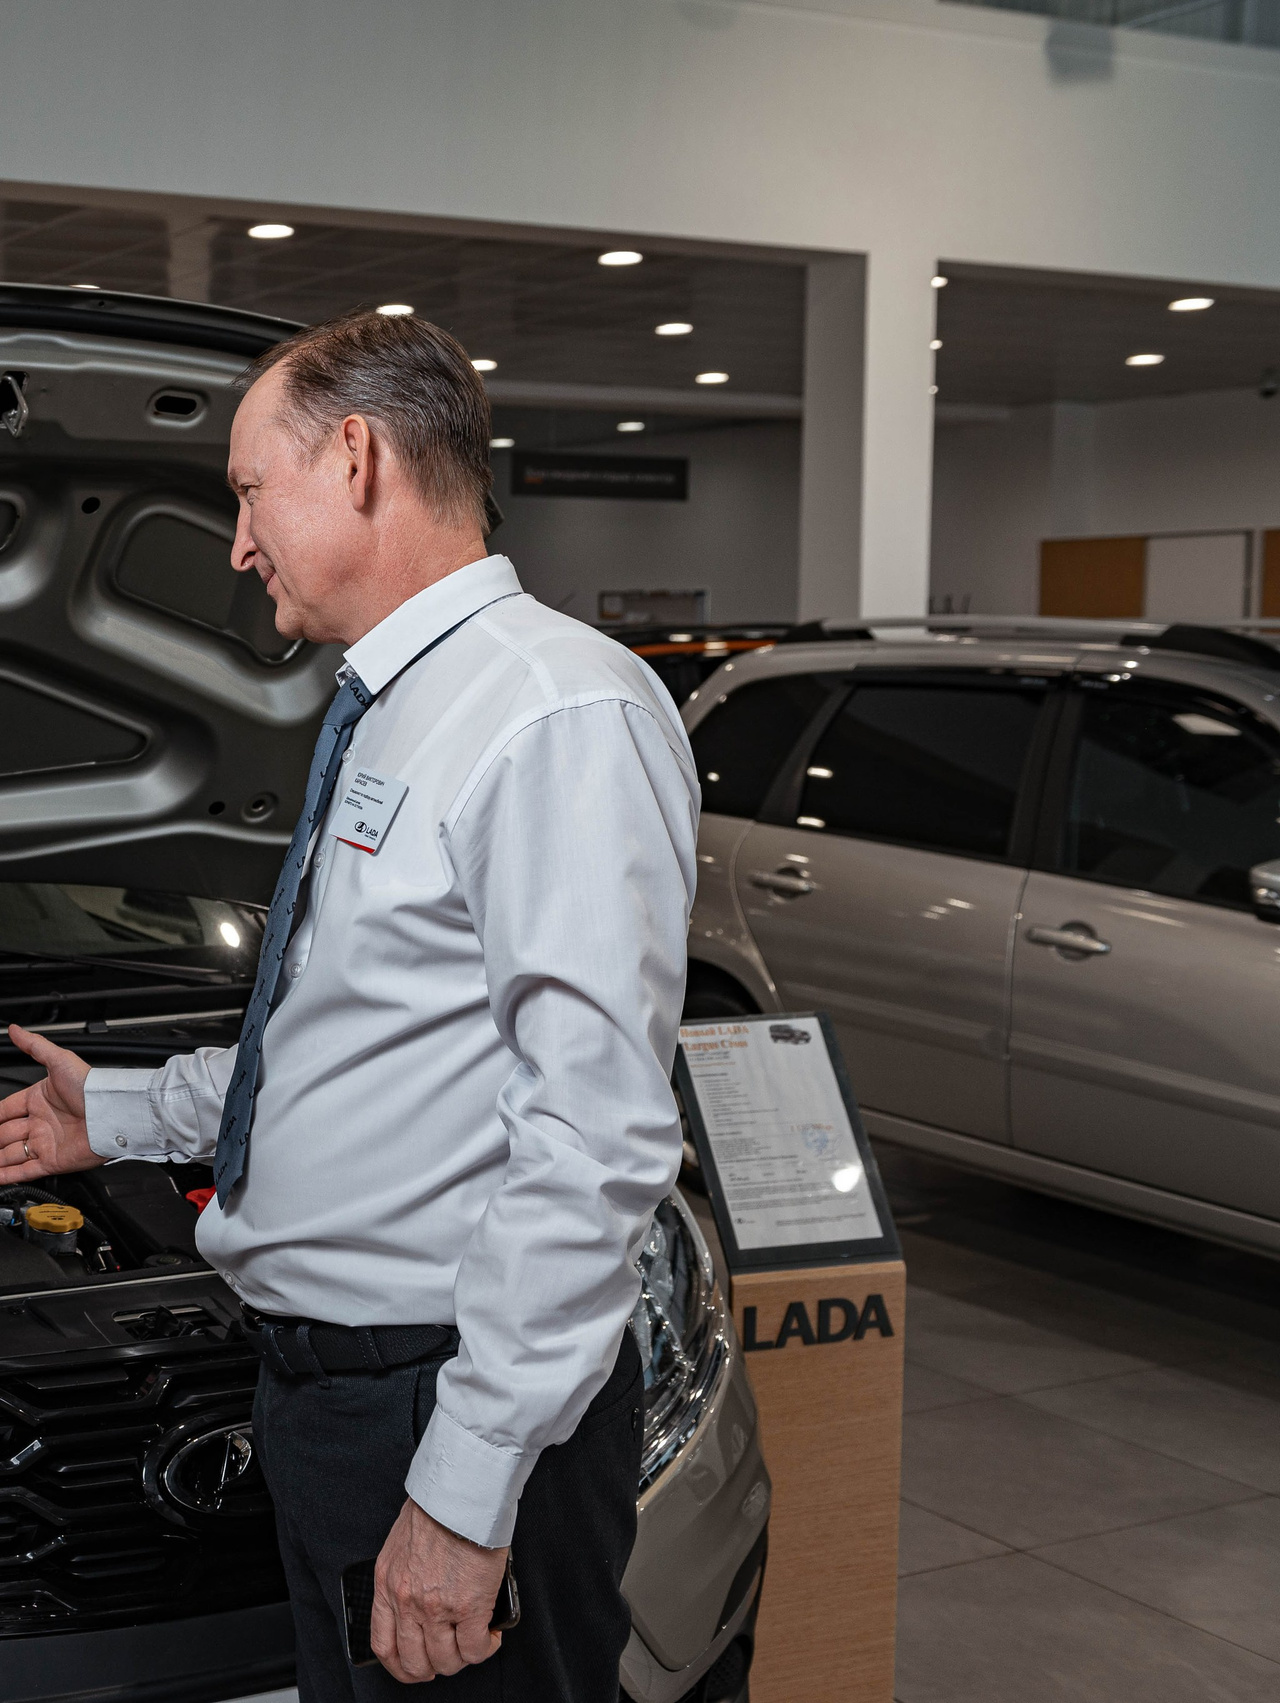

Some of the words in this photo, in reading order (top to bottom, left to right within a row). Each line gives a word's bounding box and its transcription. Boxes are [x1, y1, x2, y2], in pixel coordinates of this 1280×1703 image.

[349, 680, 371, 708] LADA
[365, 827, 379, 838] LADA
[742, 1294, 895, 1352] LADA
